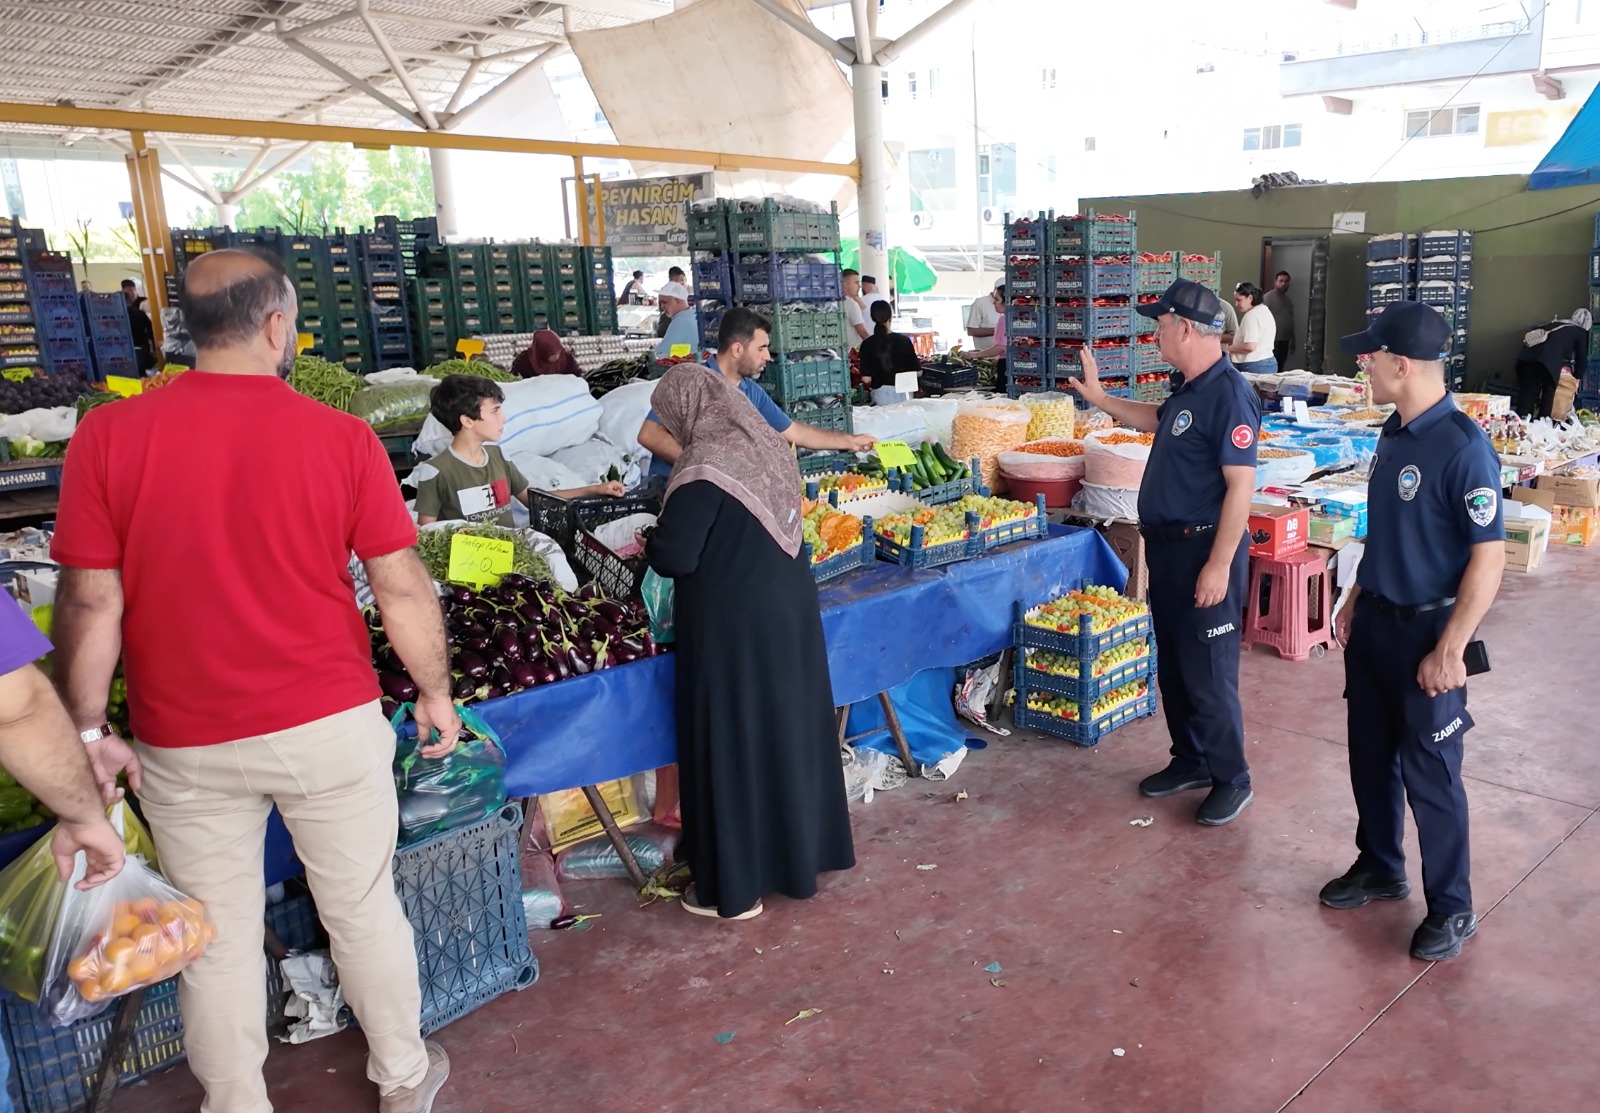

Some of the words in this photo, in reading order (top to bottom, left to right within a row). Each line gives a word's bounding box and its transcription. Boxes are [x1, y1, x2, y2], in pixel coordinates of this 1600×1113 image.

[602, 178, 695, 206] PEYNİRCİM
[615, 206, 677, 226] HASAN
[667, 231, 687, 243] Loras
[1206, 622, 1235, 638] ZABITA
[1432, 716, 1463, 743] ZABITA
